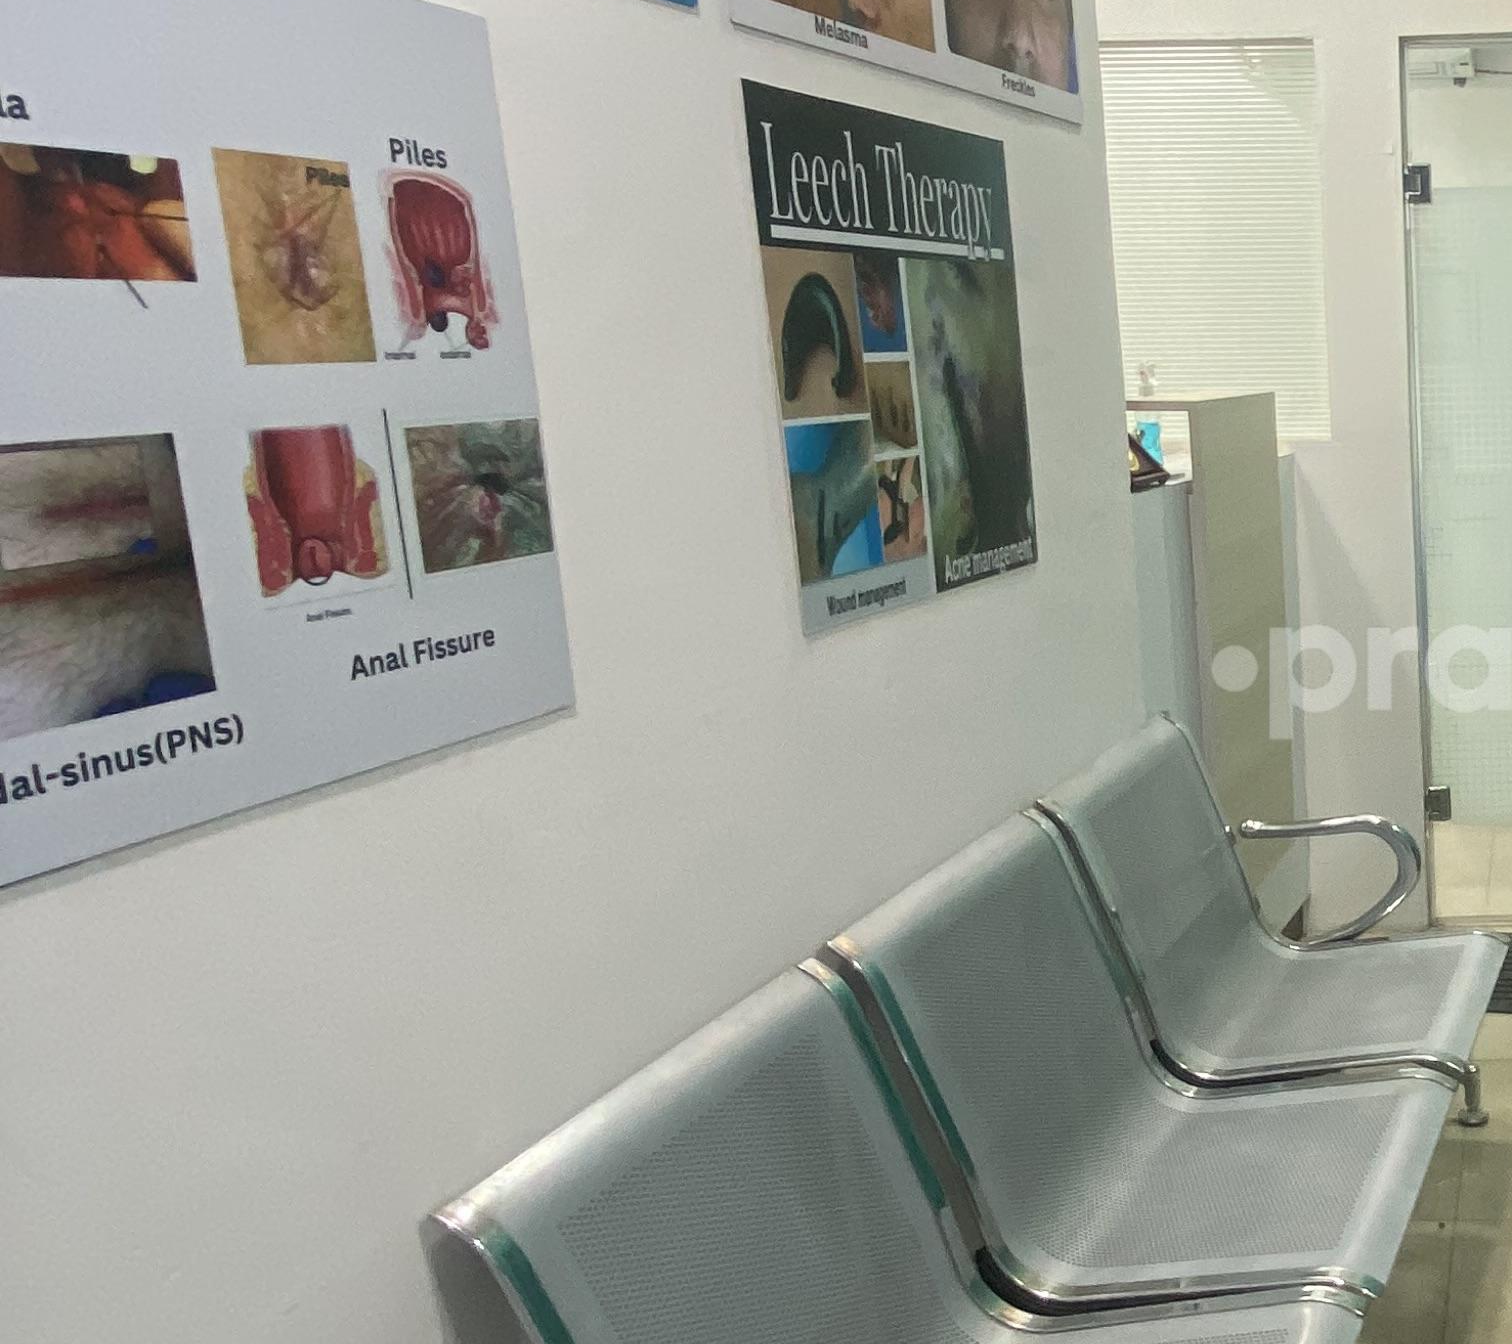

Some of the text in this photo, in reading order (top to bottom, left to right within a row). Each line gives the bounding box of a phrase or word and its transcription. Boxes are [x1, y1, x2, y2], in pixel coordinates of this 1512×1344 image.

[814, 15, 869, 50] Melasma
[389, 138, 448, 168] Piles
[760, 120, 993, 261] Leech Therapy
[944, 554, 972, 585] Acne
[350, 628, 496, 681] Anal Fissure
